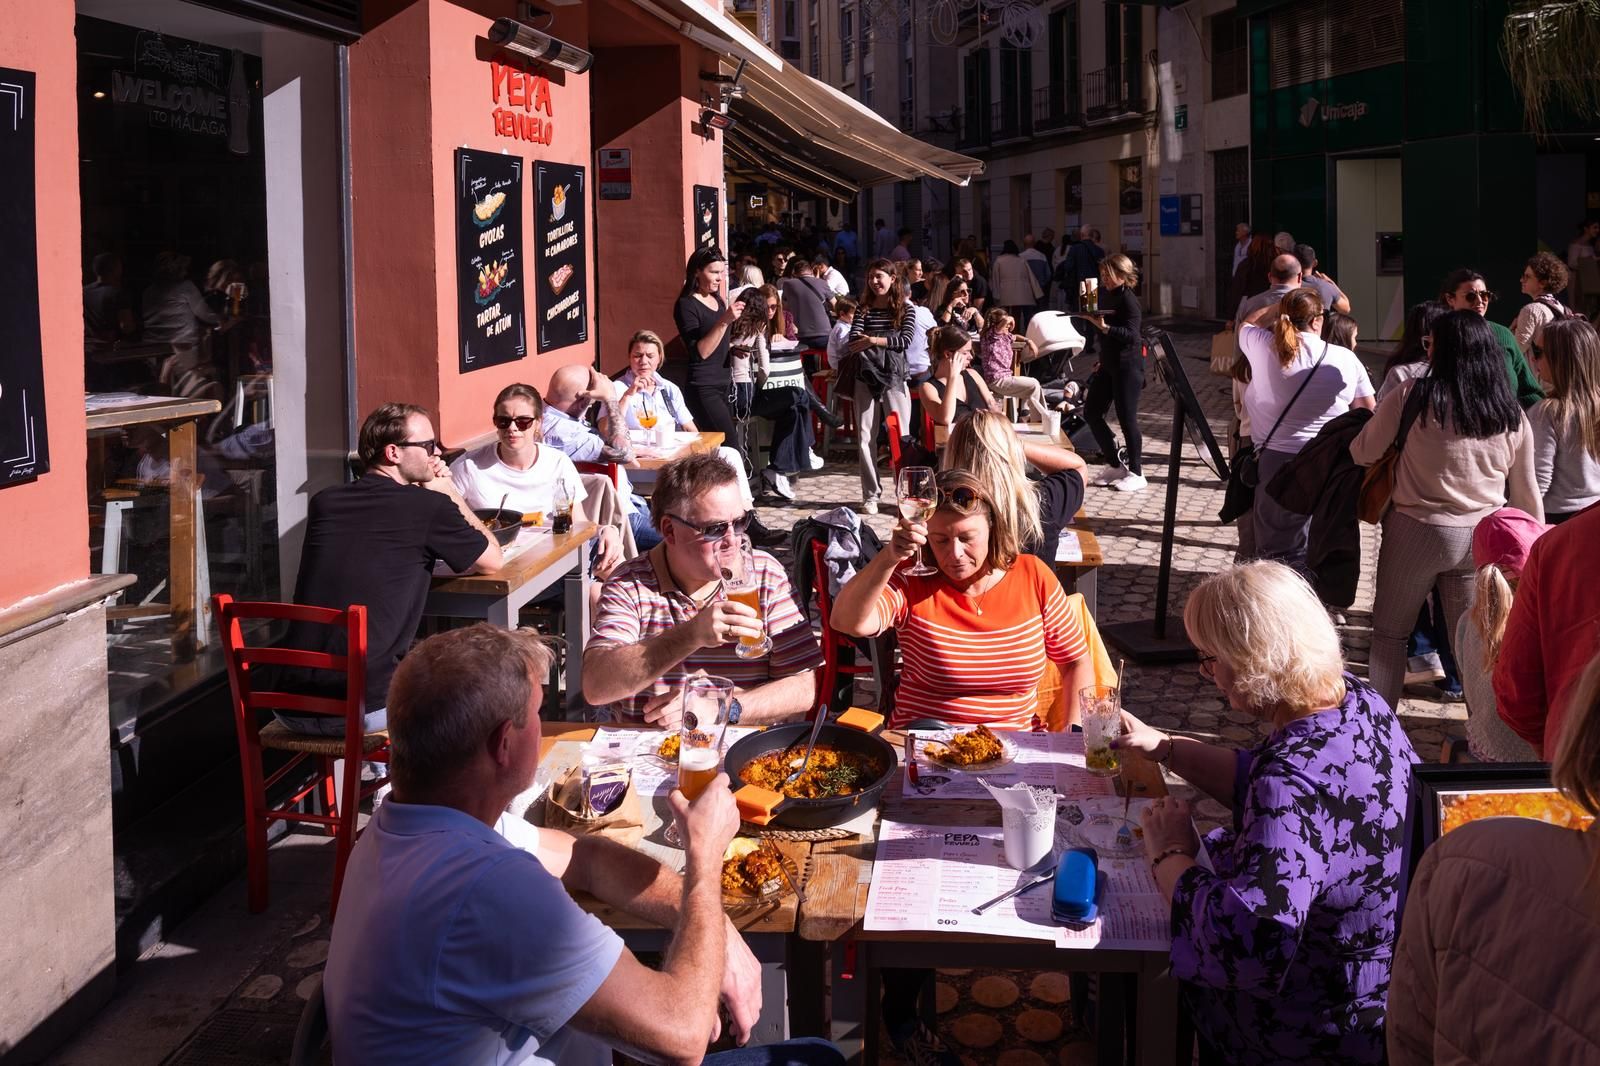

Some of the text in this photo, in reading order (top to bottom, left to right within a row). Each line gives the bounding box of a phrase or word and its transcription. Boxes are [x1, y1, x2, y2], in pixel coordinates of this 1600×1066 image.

[110, 71, 227, 119] WELCOME
[491, 58, 552, 116] PEPA
[152, 109, 168, 123] TO
[1321, 101, 1369, 122] Unicaja
[492, 107, 552, 145] REVUELO
[479, 224, 505, 248] GYOZAS
[476, 303, 501, 328] TARTAR
[486, 313, 511, 338] DE ATÚN
[944, 833, 980, 842] PEPA
